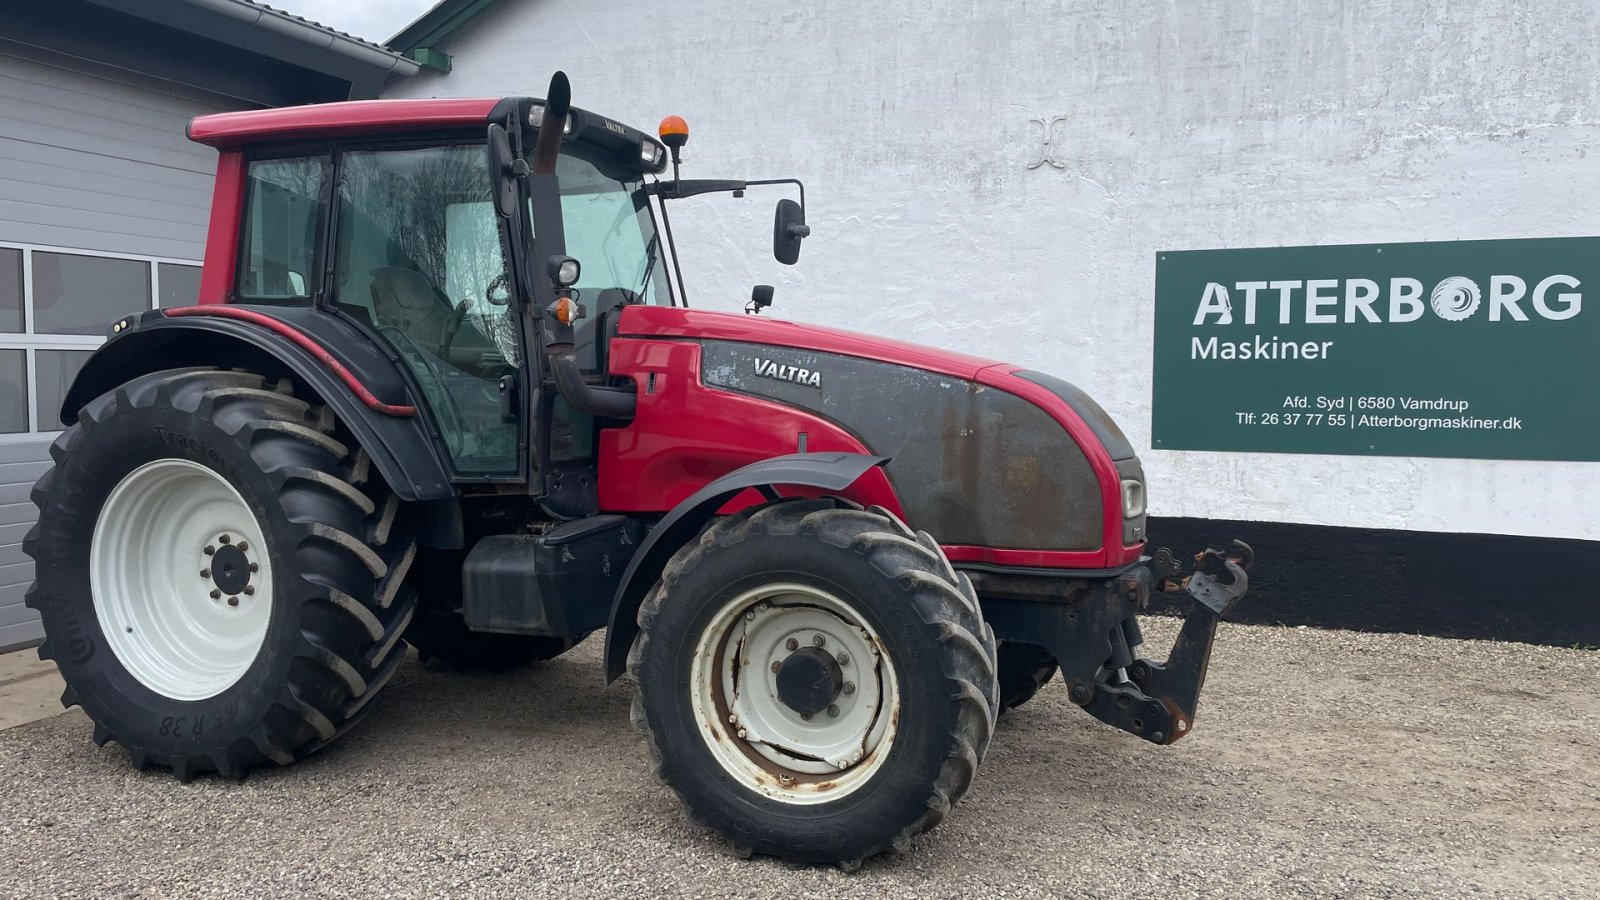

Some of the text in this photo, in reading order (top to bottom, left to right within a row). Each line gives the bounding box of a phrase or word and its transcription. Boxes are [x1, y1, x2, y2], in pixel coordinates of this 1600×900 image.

[604, 119, 625, 135] VALTRA
[1192, 274, 1582, 325] ATTERBORG
[1191, 335, 1333, 360] Maskiner
[754, 357, 822, 388] VALTRA
[1283, 396, 1312, 409] Afd.
[1316, 396, 1344, 411] Syd
[1357, 396, 1395, 409] 6580
[1400, 397, 1469, 413] Vamdrup
[1235, 412, 1257, 425] Tlf:
[1261, 413, 1279, 425] 26
[1283, 413, 1301, 425] 37
[1305, 413, 1323, 425] 77
[1327, 414, 1346, 426] 55
[1358, 414, 1522, 430] Atterborgmaskiner.dk
